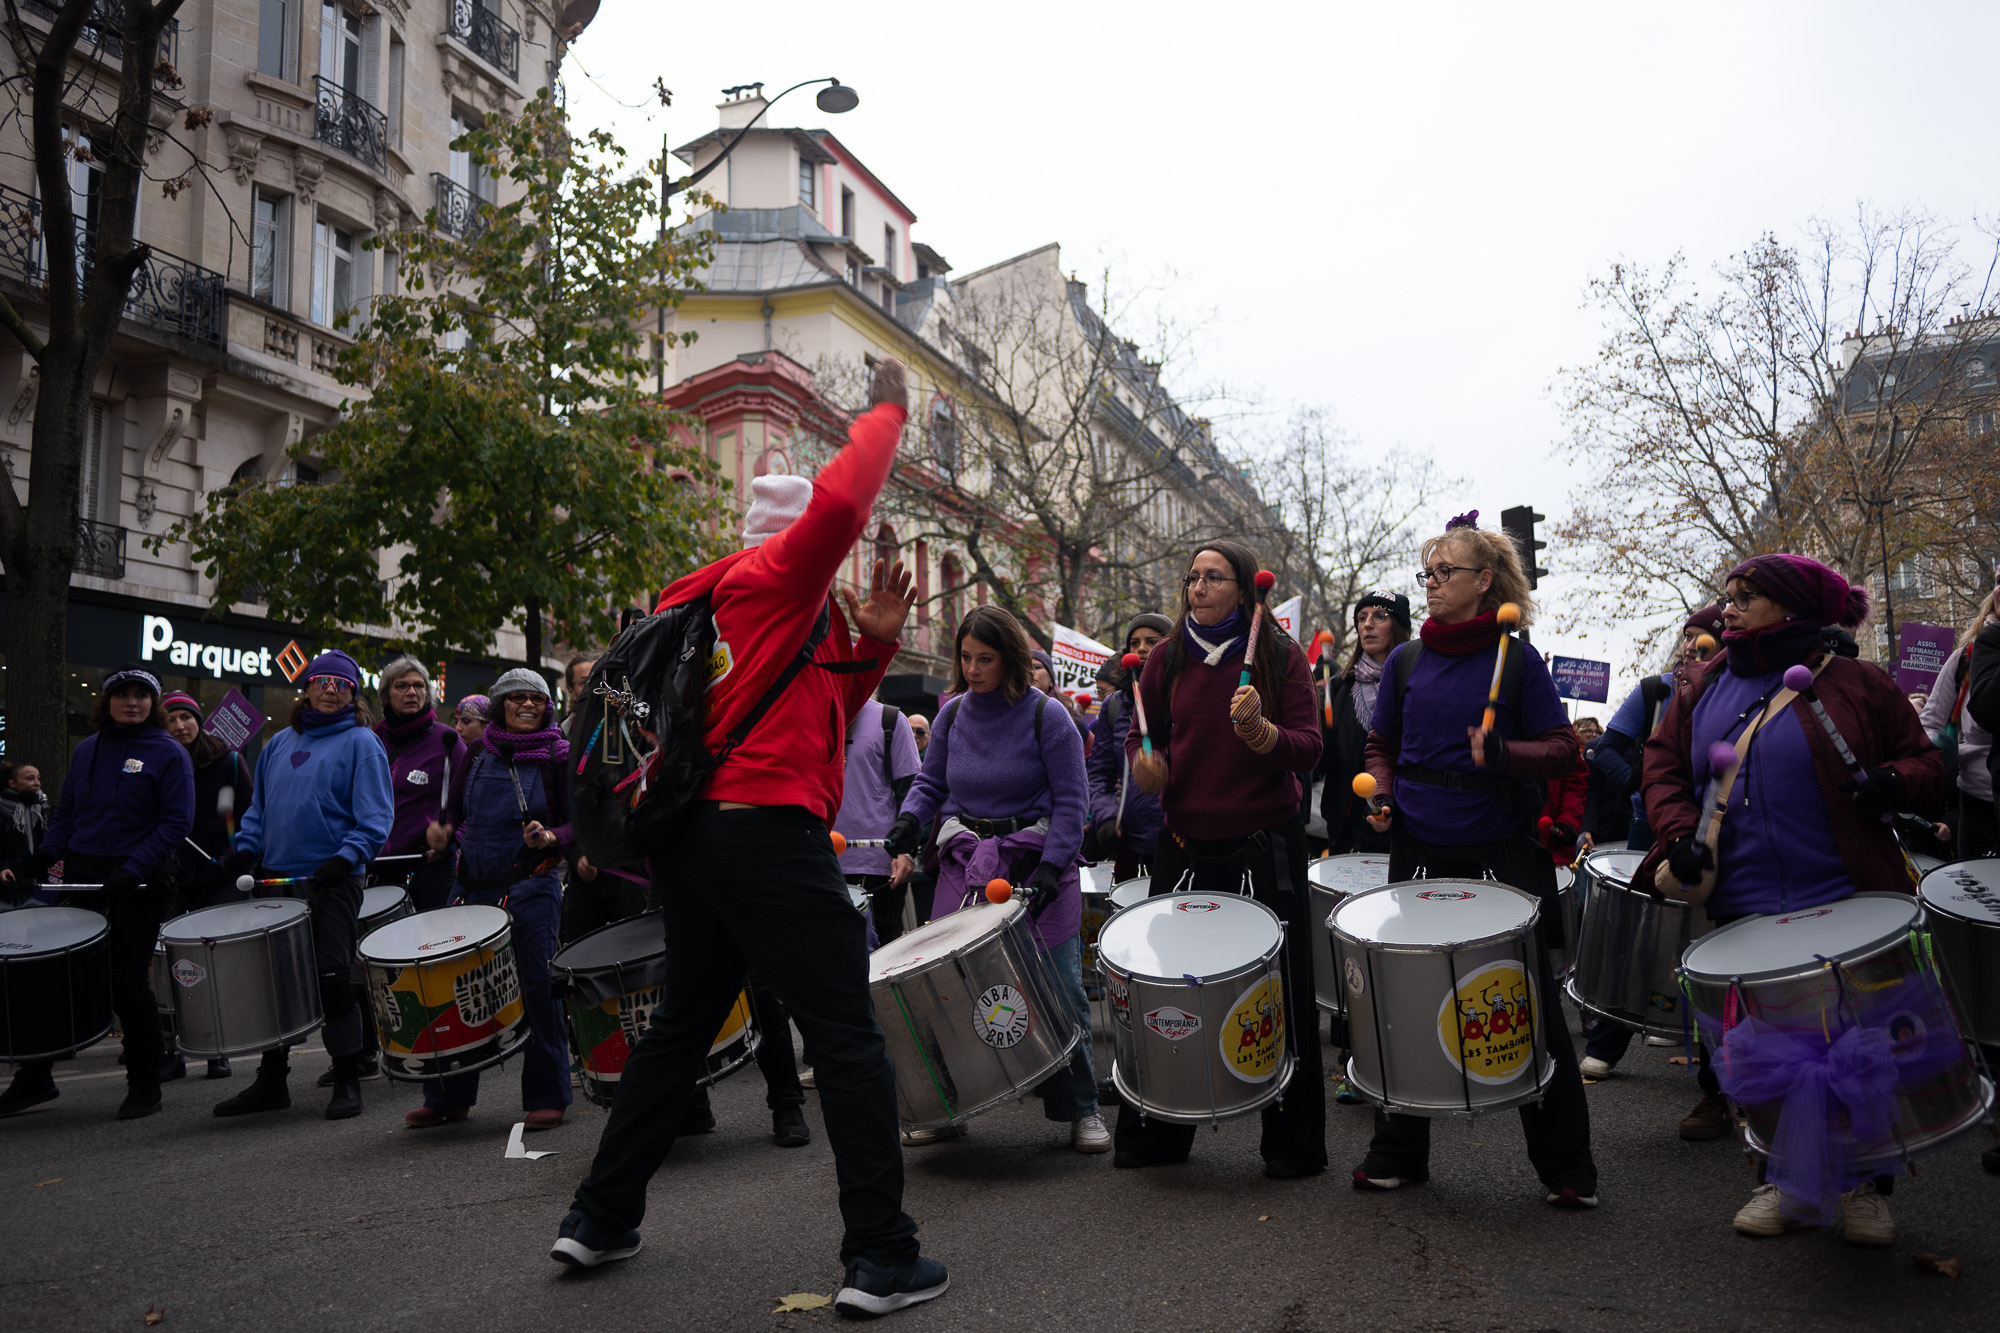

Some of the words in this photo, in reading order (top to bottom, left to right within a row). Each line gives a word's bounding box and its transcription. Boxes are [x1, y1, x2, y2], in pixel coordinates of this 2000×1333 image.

[141, 614, 272, 678] Parquet
[1906, 646, 1945, 657] DÉFINANCÉES
[1917, 640, 1937, 648] ASSOS
[1084, 651, 1108, 665] RÉVO
[1911, 655, 1938, 664] VICTIMES
[1053, 656, 1096, 678] ONTRE
[981, 986, 1009, 1008] OBA
[985, 1013, 1028, 1046] BRASIL
[1165, 1027, 1190, 1039] light
[1485, 1034, 1531, 1055] TAMBOUR
[1237, 1053, 1253, 1065] LES
[1255, 1050, 1276, 1069] D'IVR
[1485, 1051, 1520, 1067] D'IVRY
